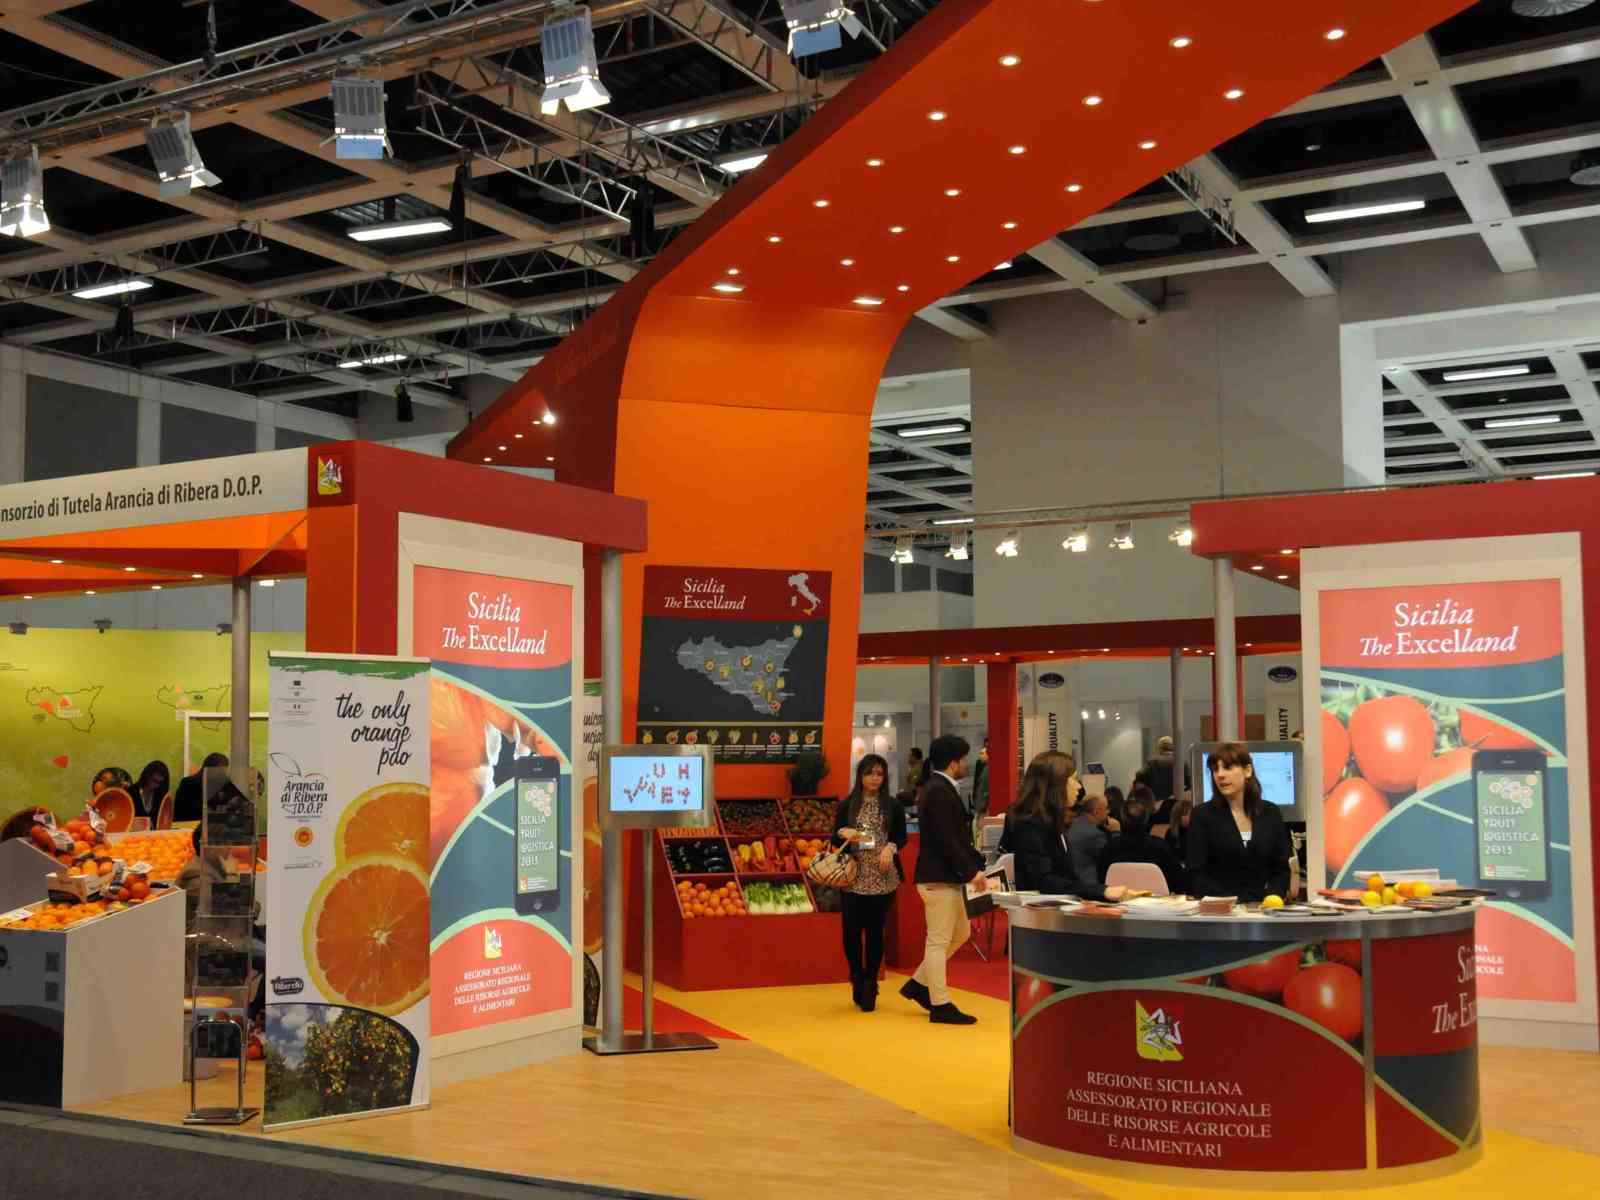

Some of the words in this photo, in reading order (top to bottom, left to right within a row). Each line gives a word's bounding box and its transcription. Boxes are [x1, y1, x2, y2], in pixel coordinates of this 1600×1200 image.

[0, 500, 44, 522] nsorzio
[48, 497, 59, 517] di
[62, 493, 101, 515] Tutela
[105, 488, 154, 511] Arancia
[158, 484, 170, 505] di
[174, 482, 219, 503] Ribera
[223, 475, 262, 498] D.O.P.
[683, 578, 725, 593] Sicilia
[467, 591, 521, 623] Sicilia
[664, 596, 682, 608] The
[683, 595, 746, 610] Excelland
[1394, 599, 1474, 627] Sicilia
[442, 626, 466, 649] The
[468, 624, 547, 655] Excelland
[1360, 636, 1392, 656] The
[1396, 626, 1519, 655] Excelland
[335, 692, 364, 718] the
[371, 690, 412, 726] only
[351, 724, 412, 751] orange
[1279, 707, 1289, 740] UALITY
[376, 743, 412, 775] pdo
[284, 780, 325, 793] Arancia
[294, 791, 328, 803] Ribera
[1481, 805, 1524, 816] SICILIA
[1432, 1003, 1457, 1033] The
[1087, 1071, 1153, 1091] REGIONE
[1157, 1079, 1243, 1095] SICILIANA
[1066, 1089, 1168, 1112] ASSESSORATO
[1172, 1101, 1272, 1117] REGIONALE
[1067, 1107, 1111, 1126] DELLE
[1113, 1114, 1180, 1134] RISORSE
[1183, 1122, 1272, 1138] AGRICOLE
[1108, 1134, 1118, 1148] E
[1121, 1137, 1222, 1157] ALIMENTARI
